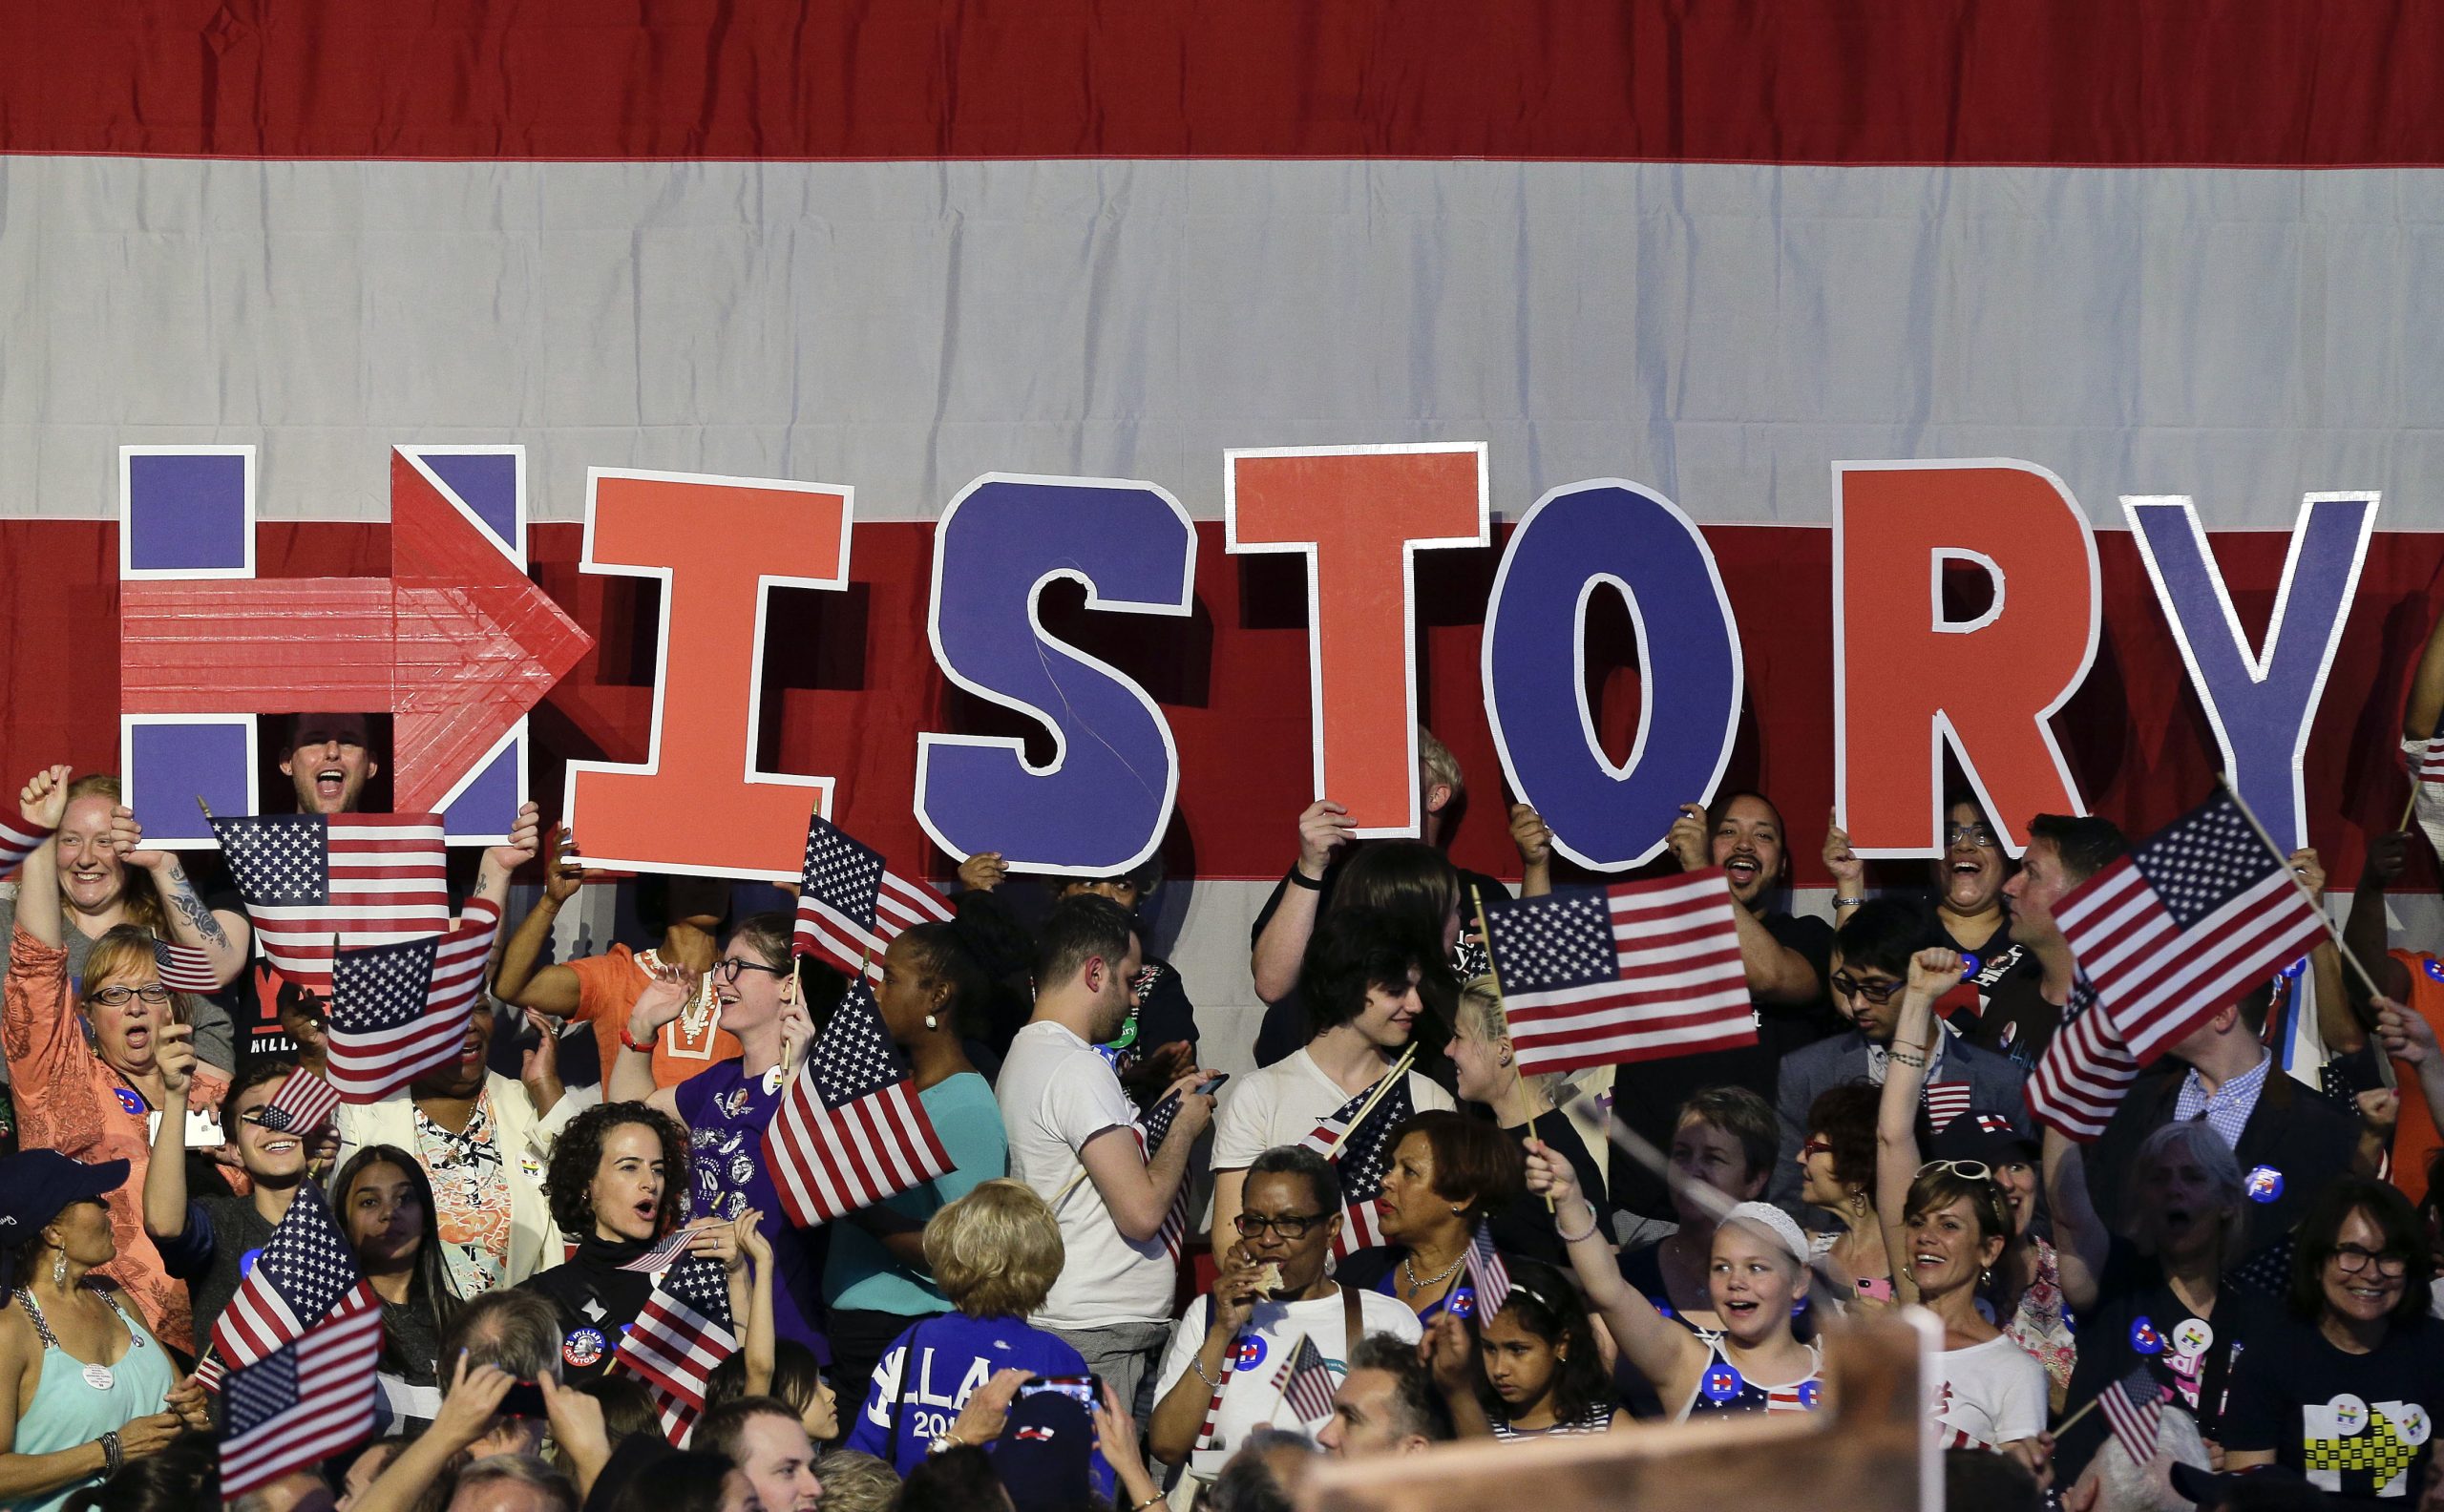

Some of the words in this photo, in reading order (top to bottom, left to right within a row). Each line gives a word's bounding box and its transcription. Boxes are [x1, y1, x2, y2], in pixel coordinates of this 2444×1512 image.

[119, 442, 2382, 882] HISTORY
[250, 1037, 299, 1054] HILL
[573, 1330, 602, 1344] HILLARY
[565, 1348, 598, 1365] CLINTON
